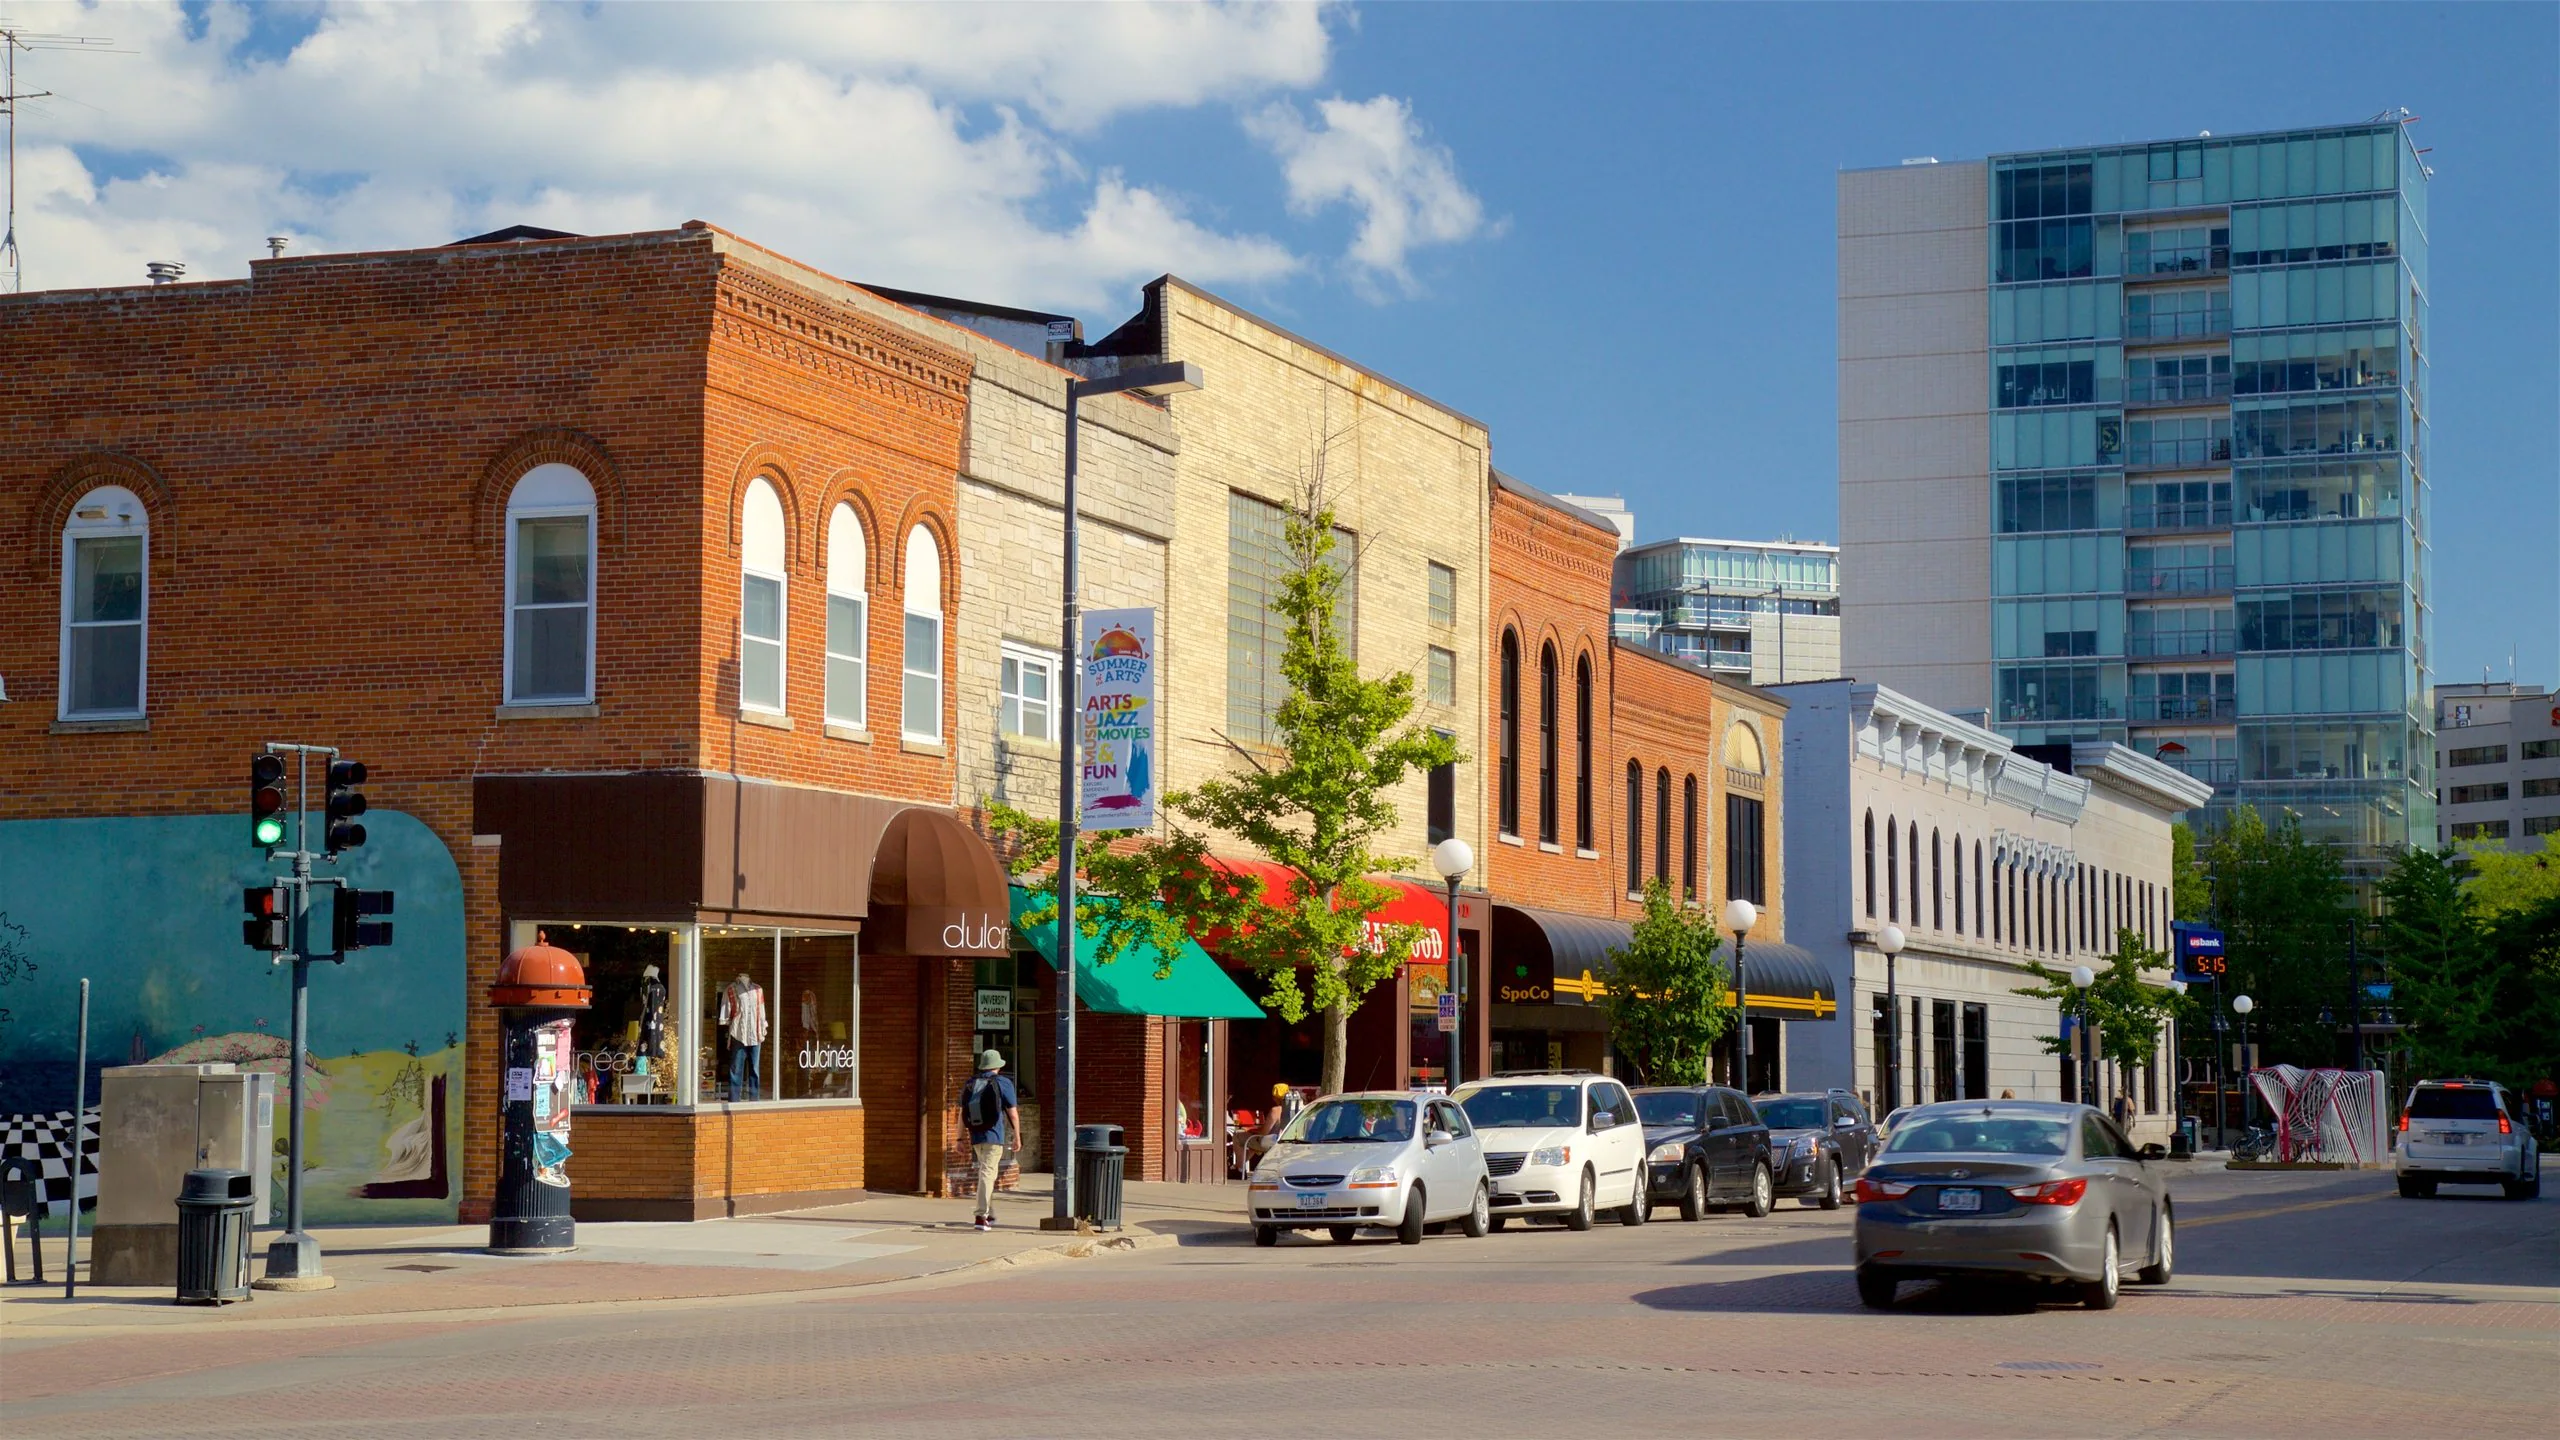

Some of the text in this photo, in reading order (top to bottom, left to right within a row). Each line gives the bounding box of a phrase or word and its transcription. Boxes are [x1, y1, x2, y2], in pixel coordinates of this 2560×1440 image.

[1088, 658, 1148, 676] SUMMER
[1104, 669, 1143, 684] ARTS
[1086, 693, 1132, 711] ARTS
[1096, 711, 1138, 727] JAZZ
[1085, 712, 1096, 765] MUSIC
[1097, 727, 1150, 740] MOVIES
[1098, 742, 1115, 763] &
[1083, 764, 1116, 780] FUN
[2198, 956, 2226, 973] 5:15
[981, 995, 1007, 1005] UNIVERSITY
[1501, 986, 1550, 1002] SpoCo
[982, 1007, 1005, 1018] CAMERA
[799, 1040, 855, 1069] dulcinéa
